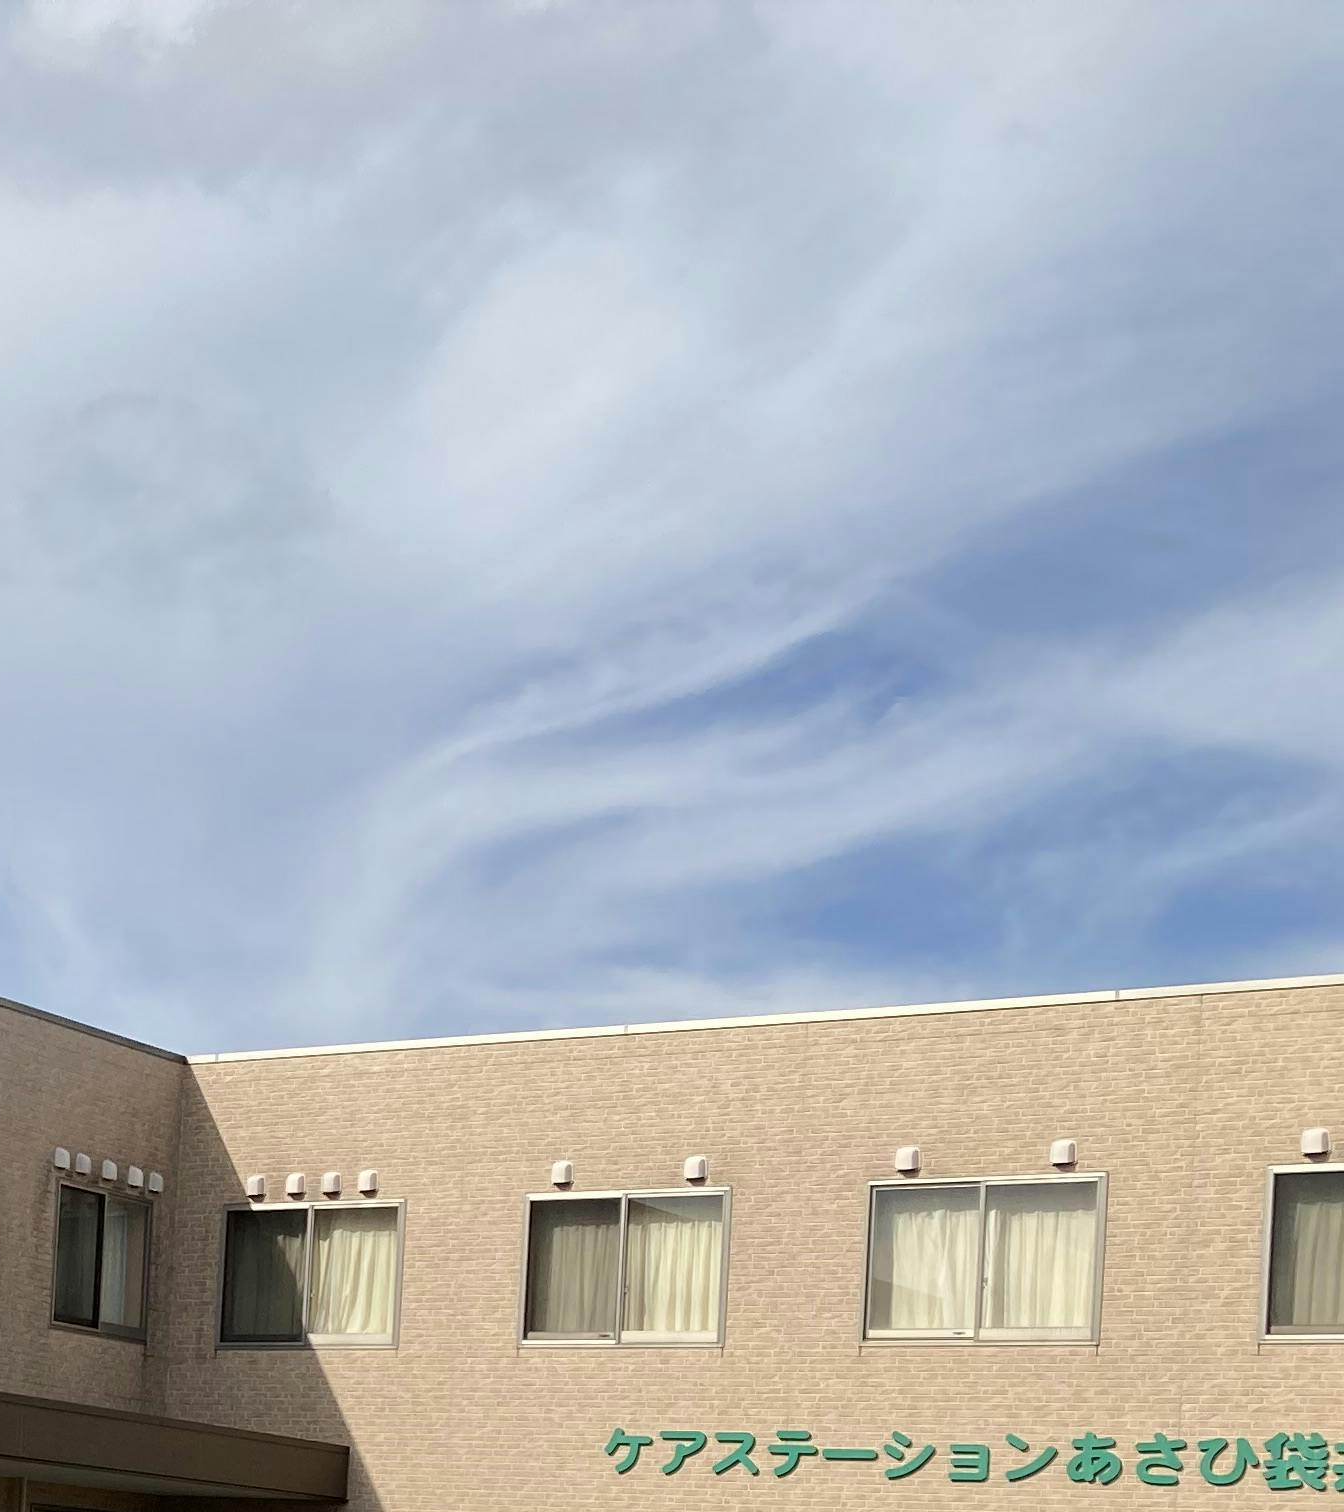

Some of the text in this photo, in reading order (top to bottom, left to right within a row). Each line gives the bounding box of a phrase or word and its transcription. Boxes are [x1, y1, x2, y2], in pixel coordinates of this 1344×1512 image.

[604, 1427, 1344, 1491] ケアステーションあさひ袋
